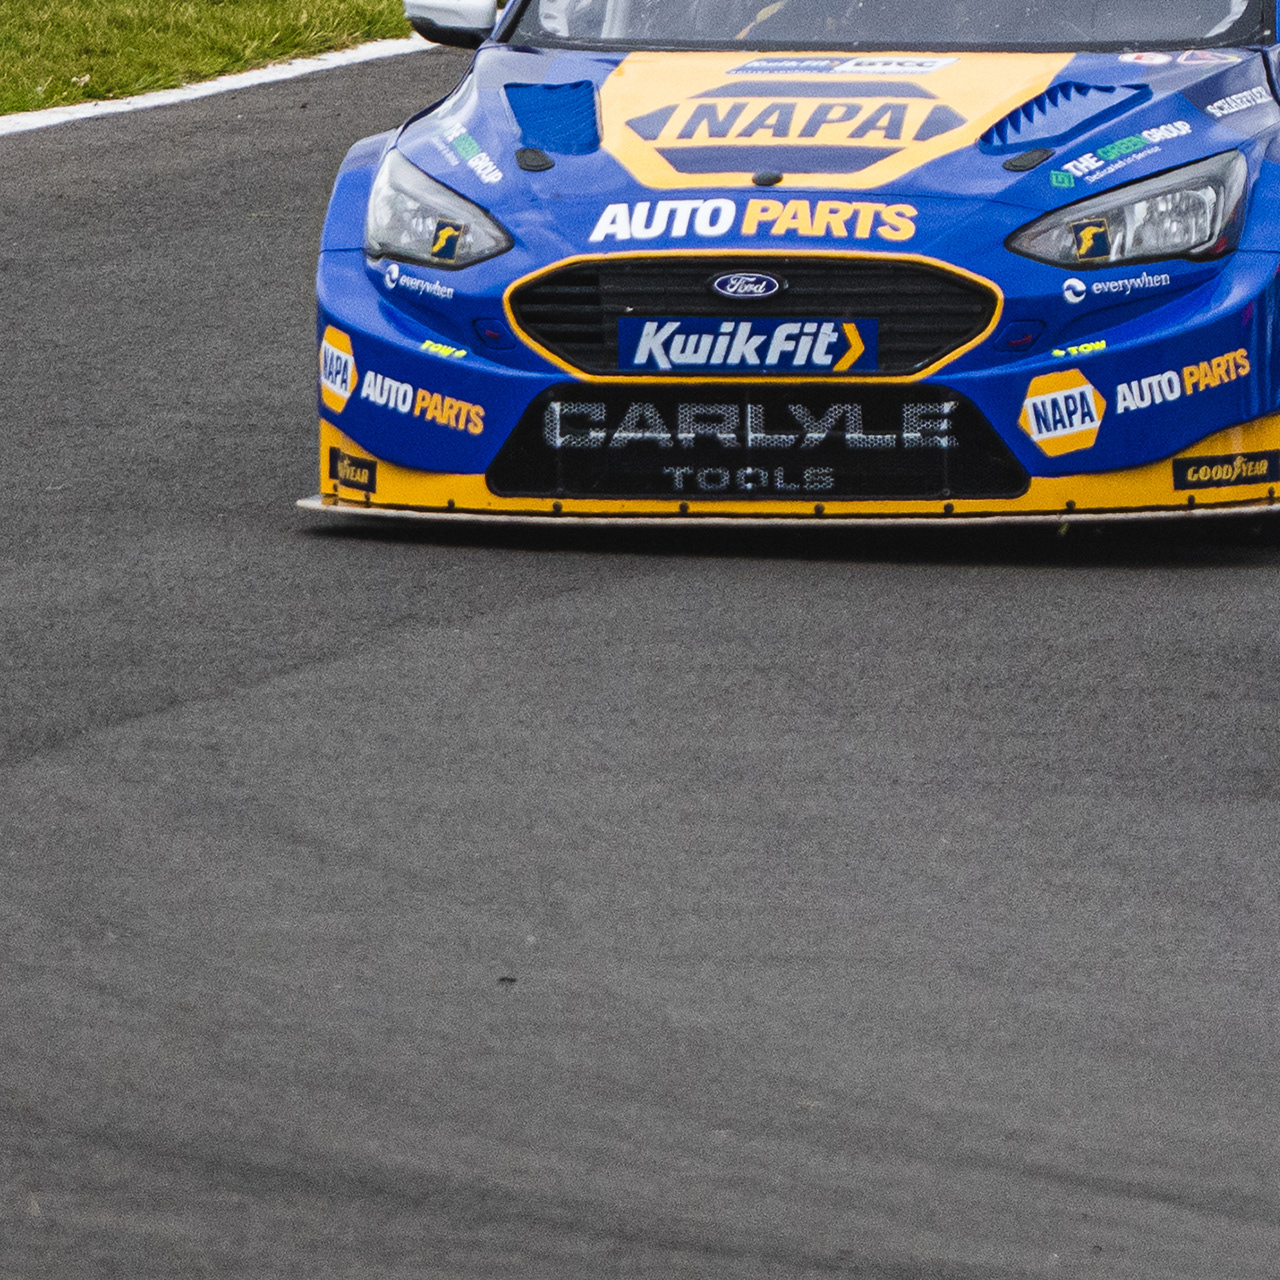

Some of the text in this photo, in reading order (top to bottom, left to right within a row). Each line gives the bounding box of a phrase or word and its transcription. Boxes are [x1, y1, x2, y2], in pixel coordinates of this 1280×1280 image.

[677, 101, 898, 140] NAPA
[1206, 86, 1273, 119] SCHAEFFLER
[1062, 152, 1104, 178] THE
[1140, 119, 1193, 144] GROUP
[589, 197, 918, 244] AUTO PARTS
[399, 272, 455, 300] everywhen
[726, 275, 768, 296] Ford
[1090, 270, 1171, 297] everywhen
[634, 320, 842, 371] KwikFit
[1066, 338, 1107, 357] TOW
[1115, 348, 1252, 416] AUTO PARTS
[361, 370, 486, 436] AUTO PARTS
[1031, 387, 1098, 436] NAPA
[541, 400, 960, 449] CARLYLE
[662, 466, 838, 492] TOOLS
[1187, 455, 1269, 483] GOODYEAR
